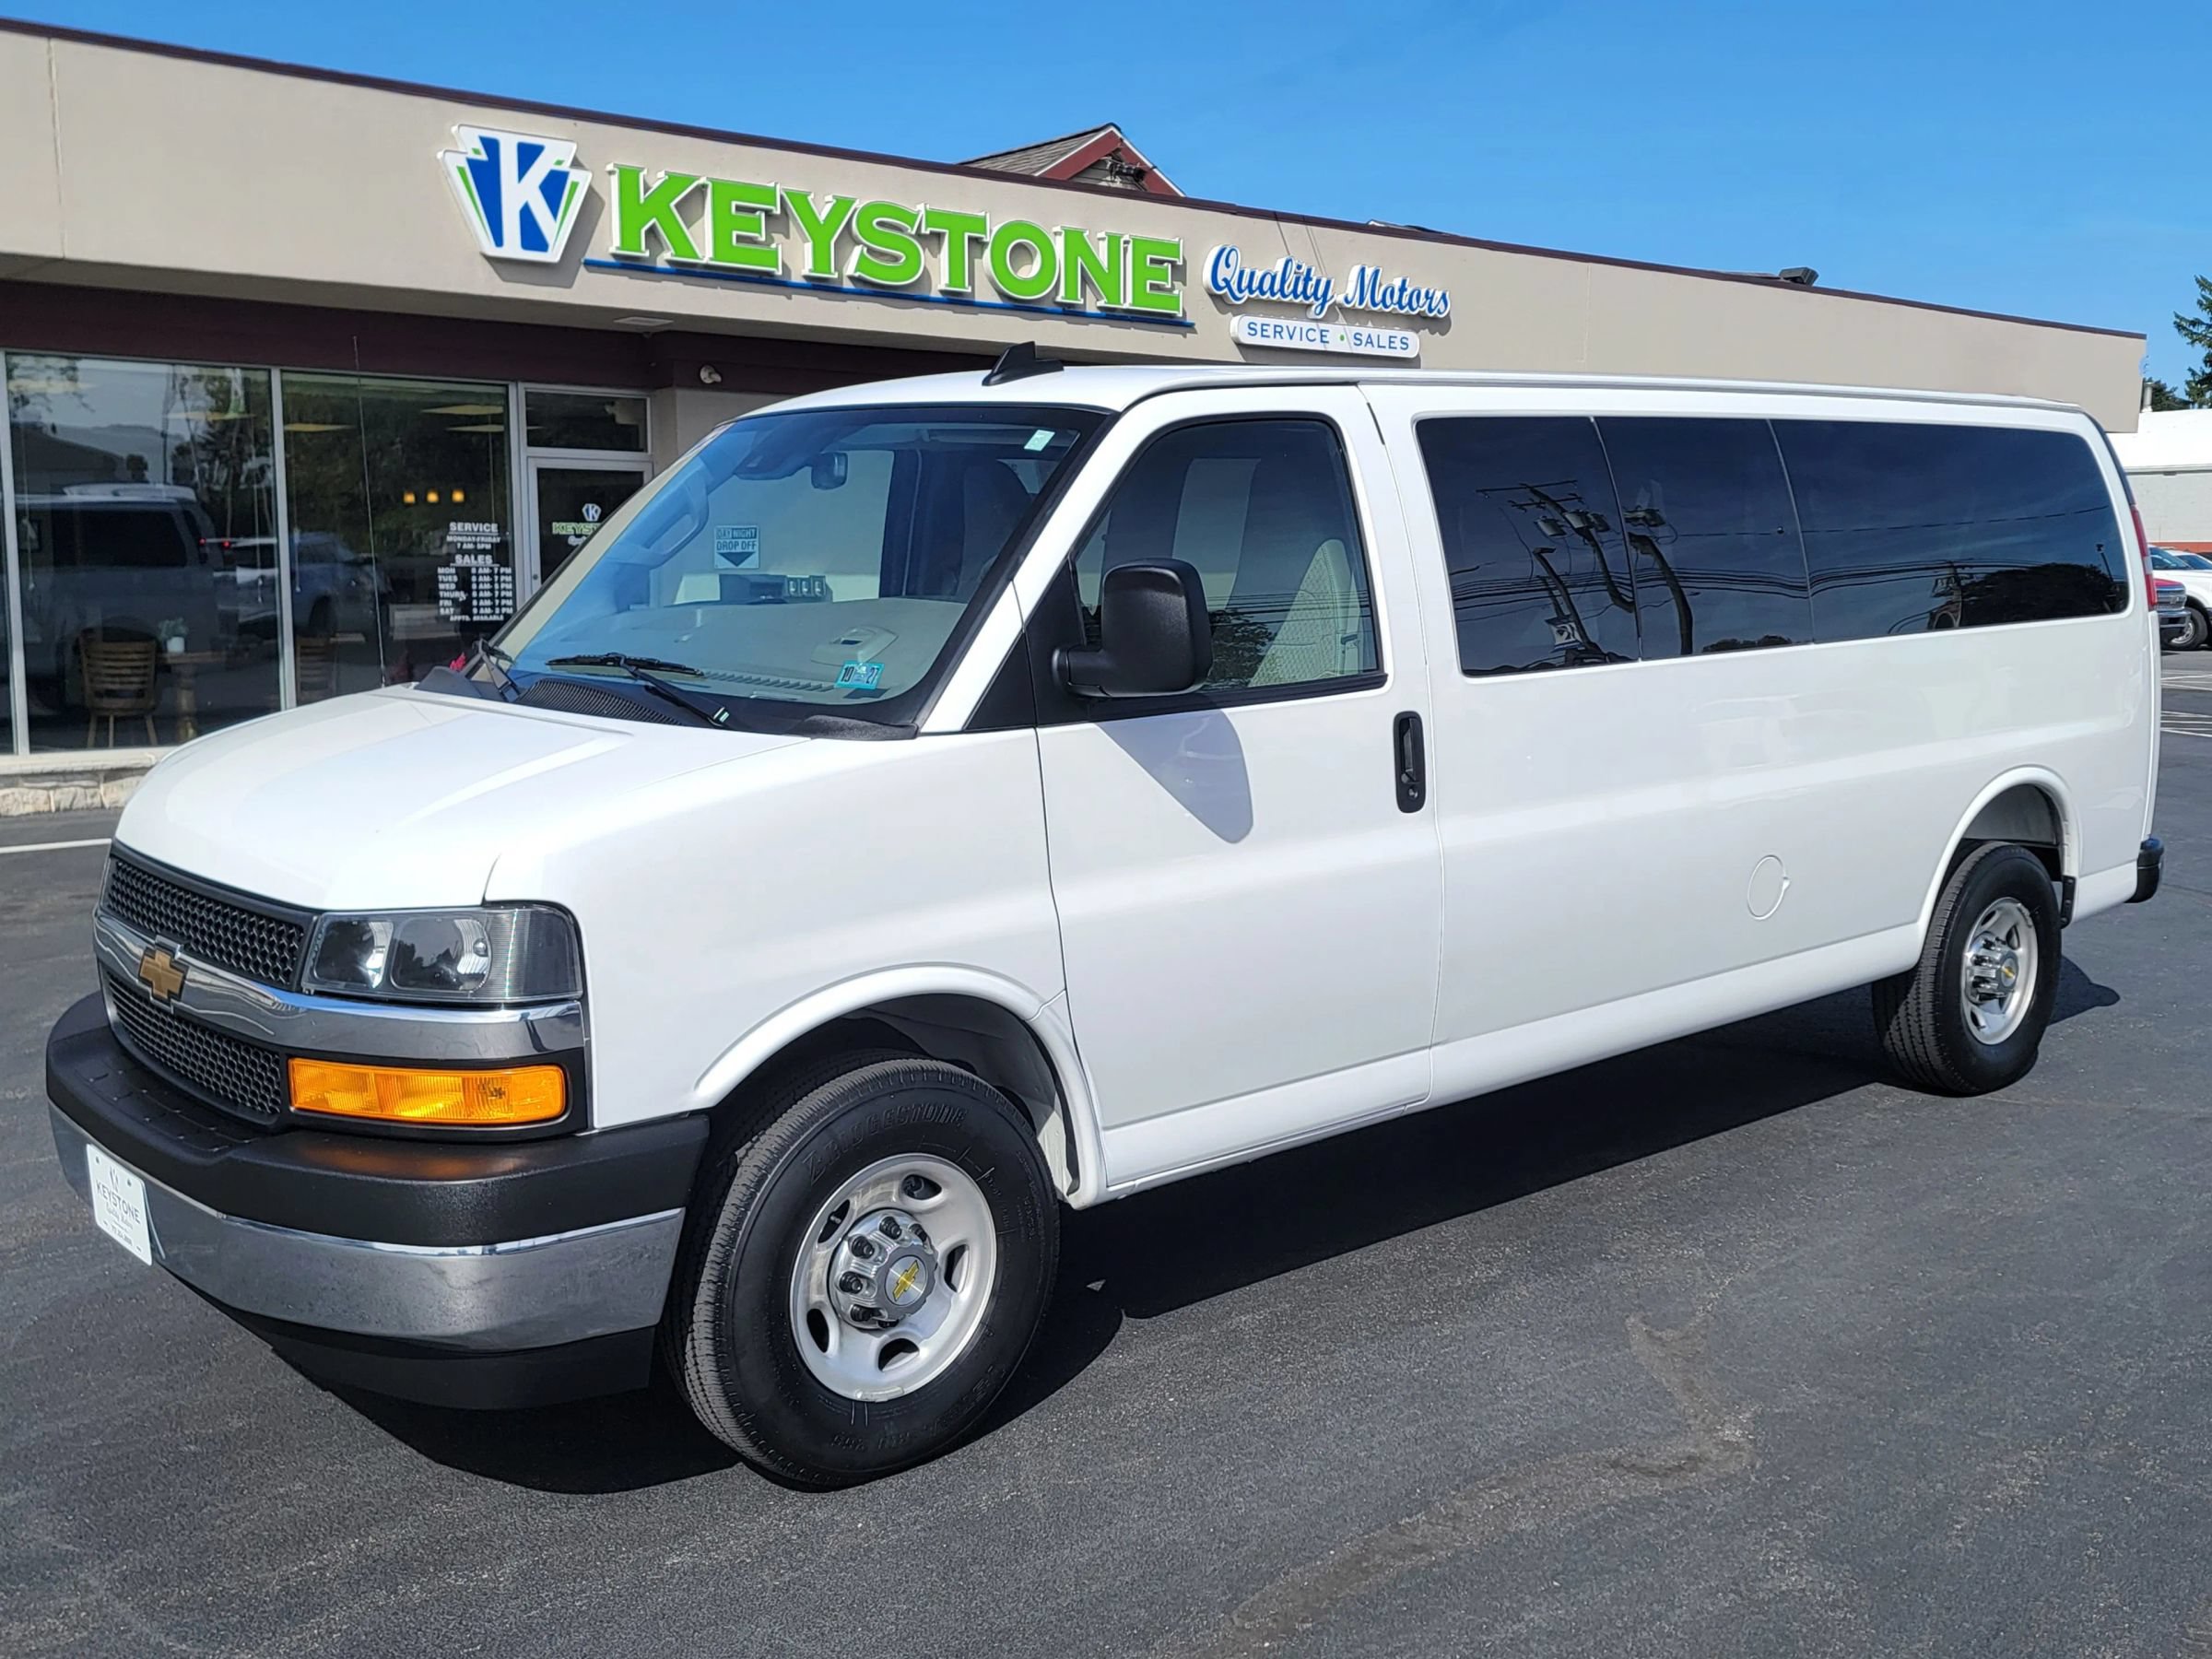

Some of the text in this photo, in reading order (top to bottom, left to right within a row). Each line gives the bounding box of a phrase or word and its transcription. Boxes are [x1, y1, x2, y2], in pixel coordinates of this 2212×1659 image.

[606, 161, 1184, 317] KEYSTONE
[1207, 245, 1451, 317] Quality Motors
[1247, 321, 1409, 351] SERVICE SALES
[449, 522, 499, 532] SERVICE
[454, 554, 493, 564] SALES
[716, 540, 757, 551] DROP OFF
[96, 1179, 141, 1225] KEYSTONE
